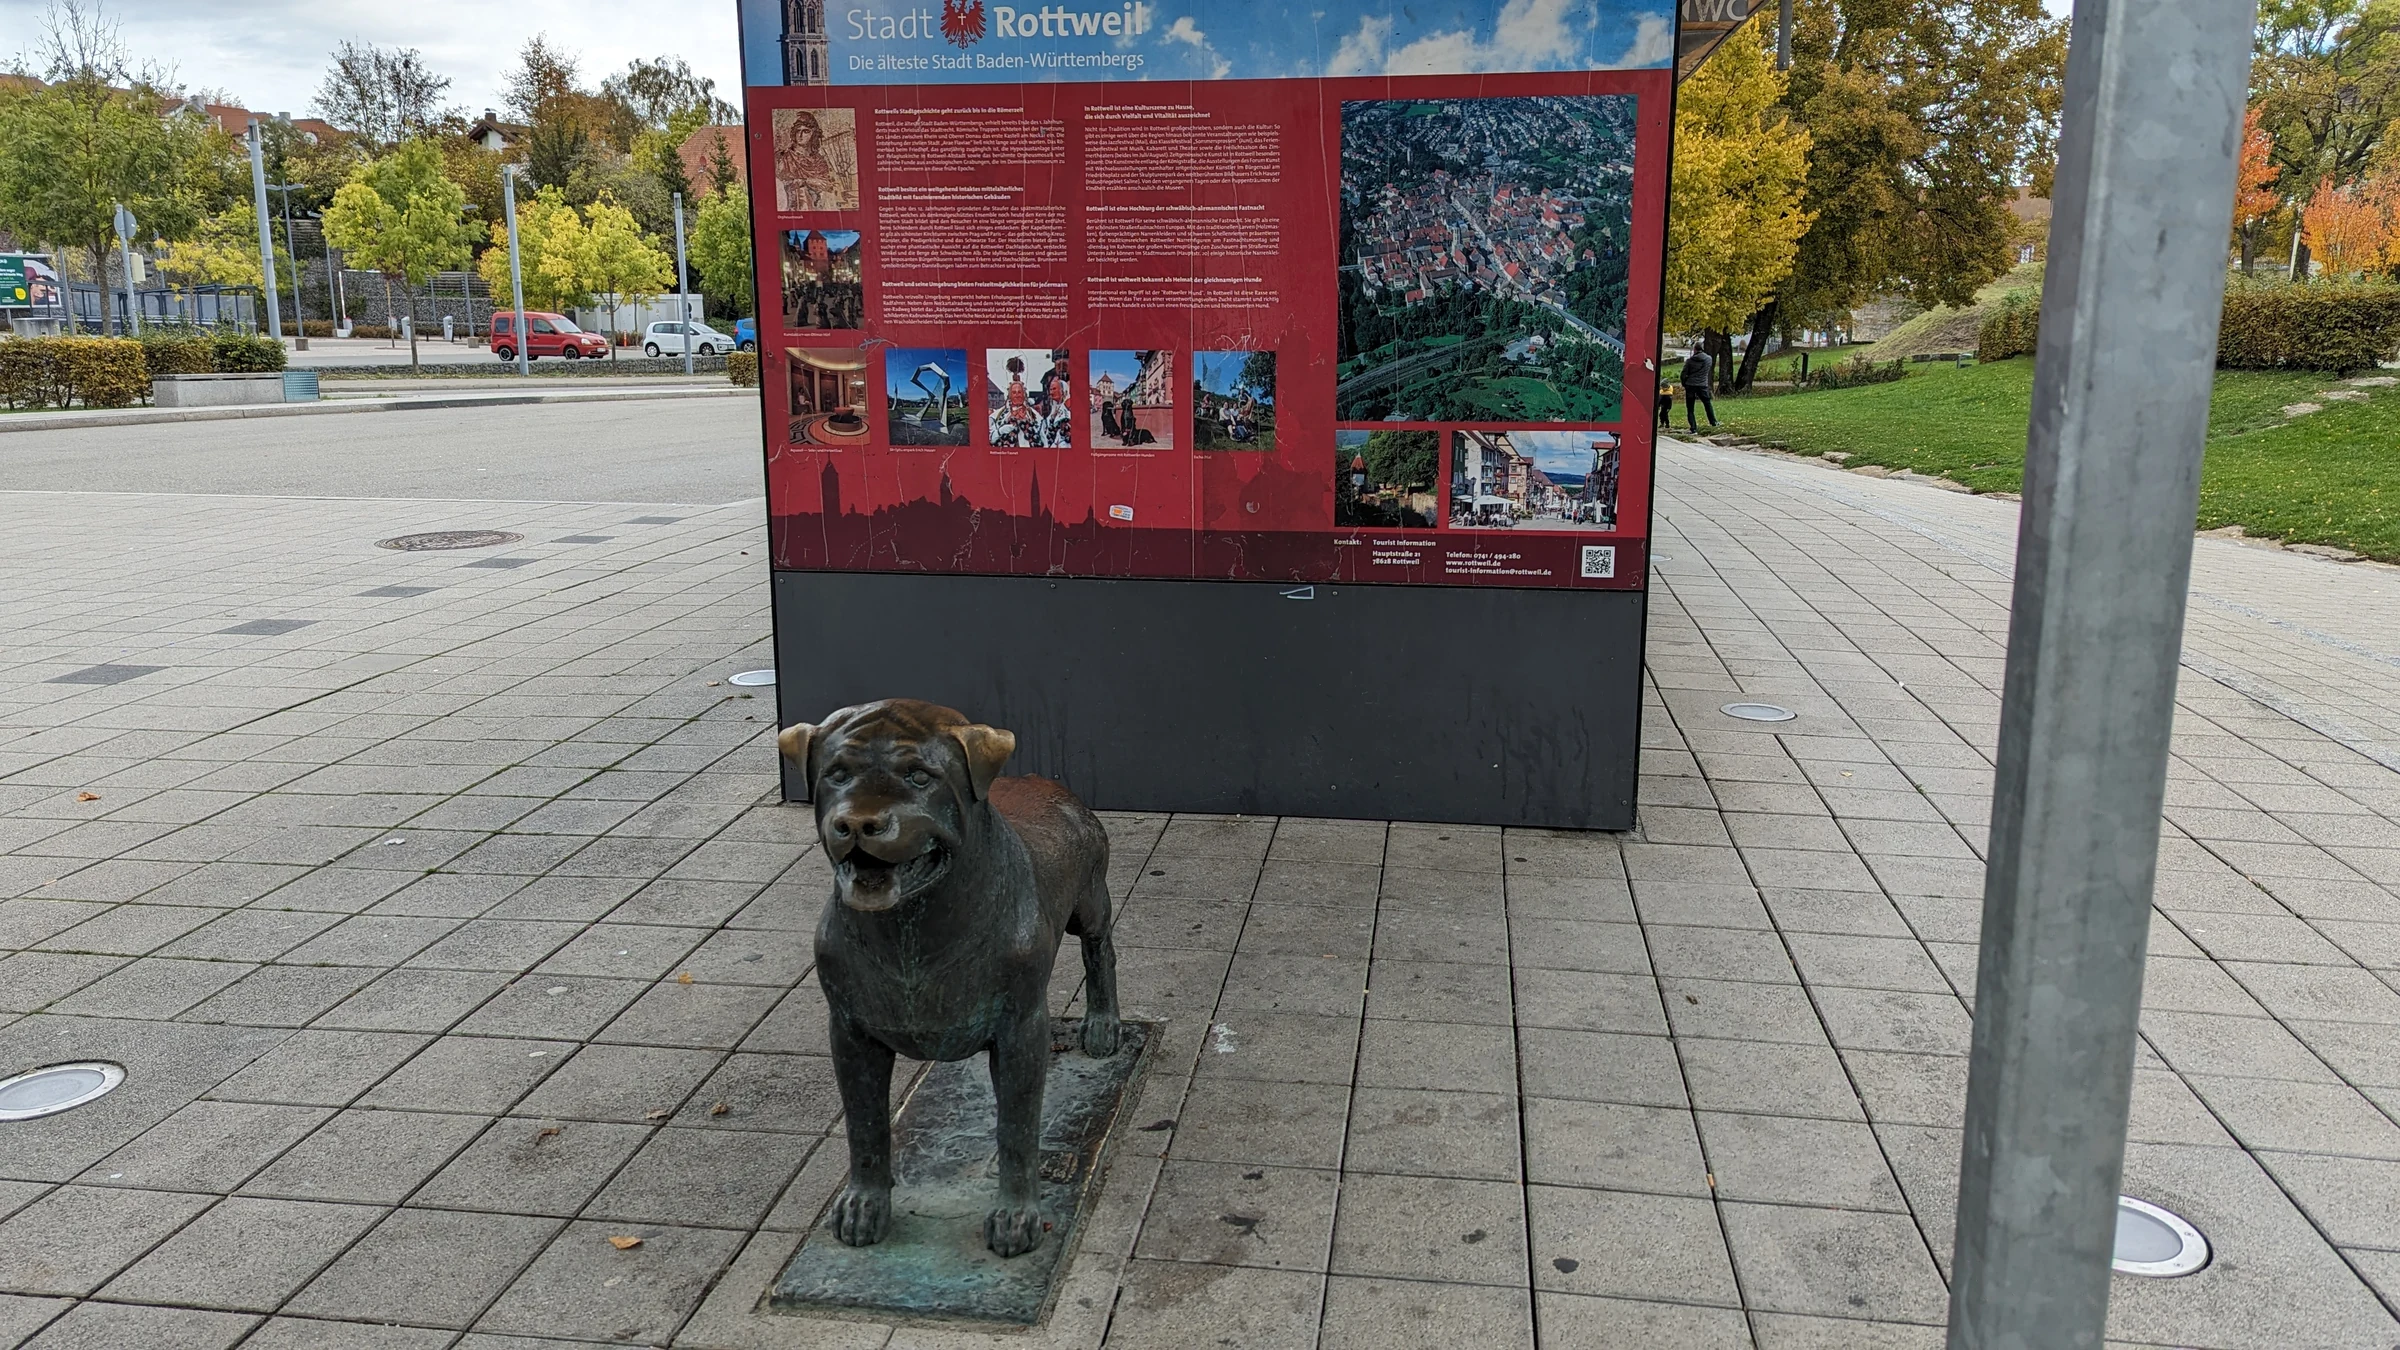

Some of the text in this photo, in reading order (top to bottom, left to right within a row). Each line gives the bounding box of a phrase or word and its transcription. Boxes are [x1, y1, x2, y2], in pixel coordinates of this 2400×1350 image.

[847, 1, 1143, 40] Stadt Rottweil
[1695, 0, 1747, 21] WC
[849, 50, 1144, 71] Die älteste Stadt Baden-Württembergs
[1445, 568, 1552, 576] tourist-information@rottweil.de
